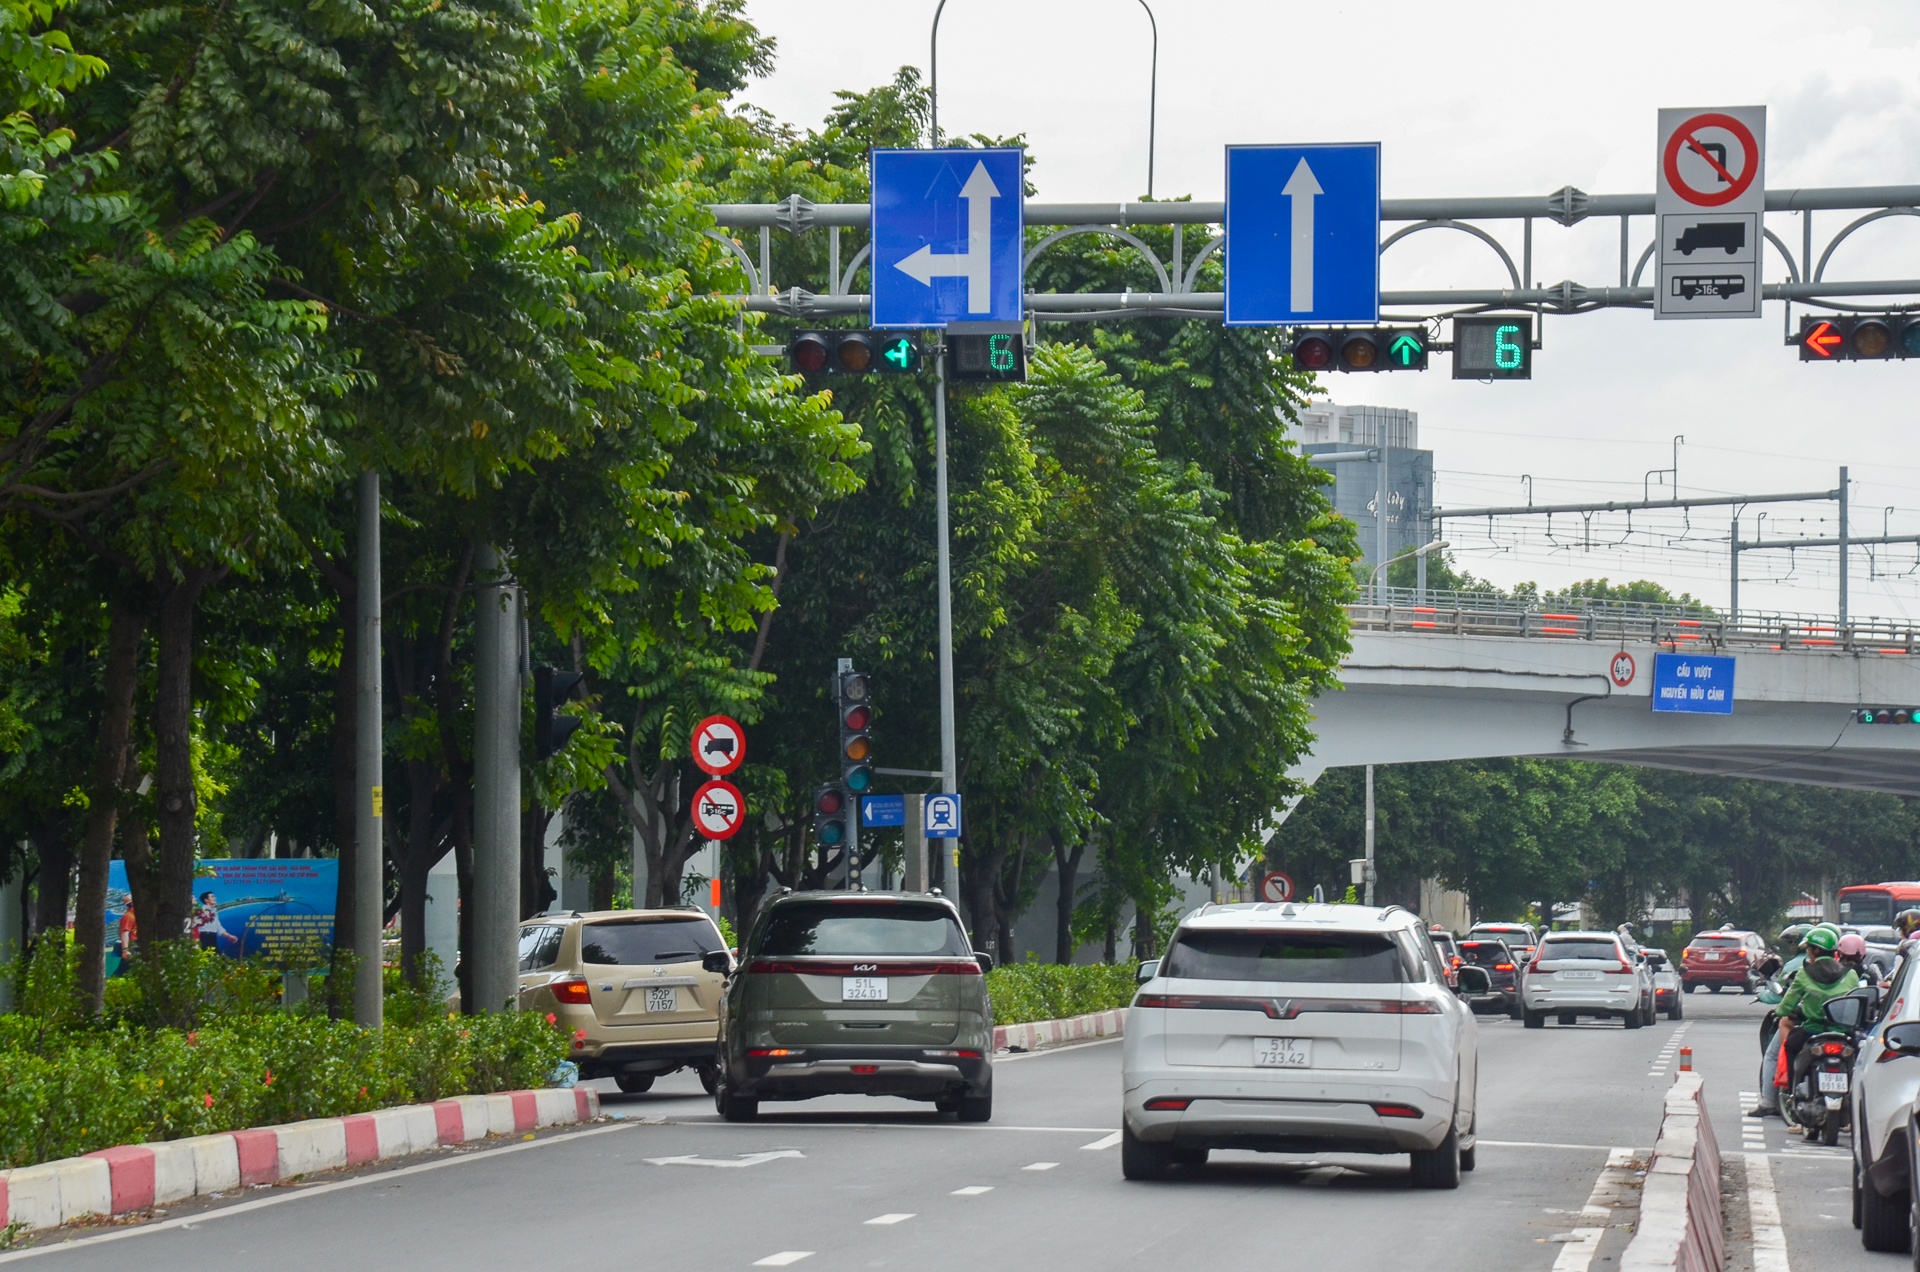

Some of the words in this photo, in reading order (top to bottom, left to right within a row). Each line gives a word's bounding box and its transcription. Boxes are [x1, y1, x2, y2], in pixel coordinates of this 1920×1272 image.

[1695, 285, 1718, 295] >16c
[989, 334, 1014, 370] 6
[1495, 325, 1521, 369] 6
[1811, 934, 1826, 943] Grab
[855, 978, 875, 989] 51L
[652, 989, 670, 1000] 52P
[847, 988, 883, 999] 324.01
[649, 1000, 673, 1010] 7157
[1270, 1039, 1295, 1051] 51K
[1260, 1051, 1305, 1065] 733.42
